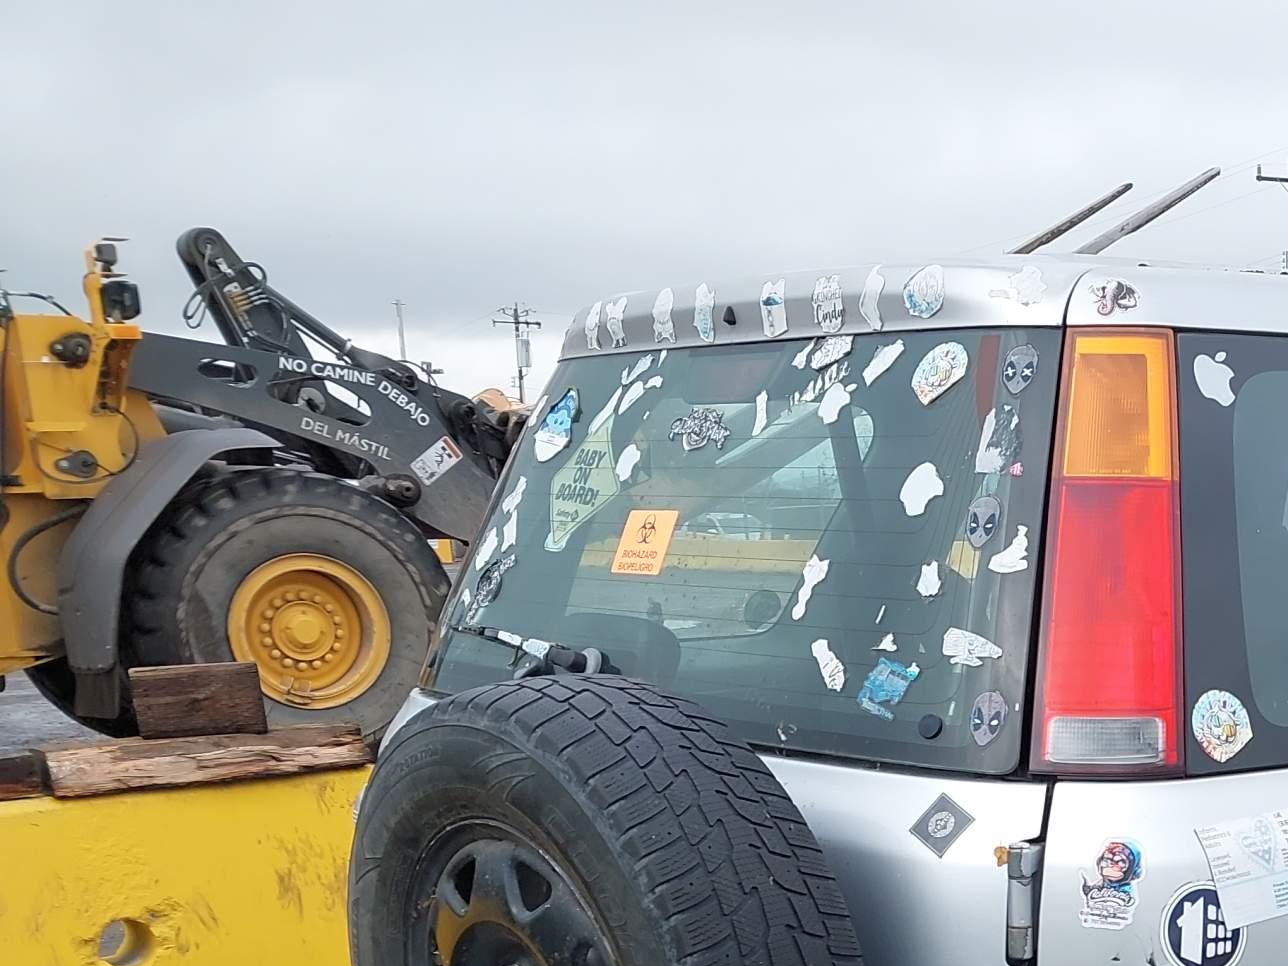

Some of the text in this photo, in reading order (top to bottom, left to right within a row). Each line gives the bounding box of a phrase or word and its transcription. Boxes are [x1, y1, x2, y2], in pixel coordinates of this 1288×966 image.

[816, 301, 845, 324] Cindy
[279, 356, 430, 426] NO CAMINE DEBAJO
[301, 417, 392, 461] DEL MÁSTIL
[575, 449, 606, 469] BABY
[573, 468, 592, 485] ON
[555, 483, 600, 508] BOARD!
[621, 550, 658, 560] BIOHAZARD
[617, 562, 654, 573] BIOPELIGRO
